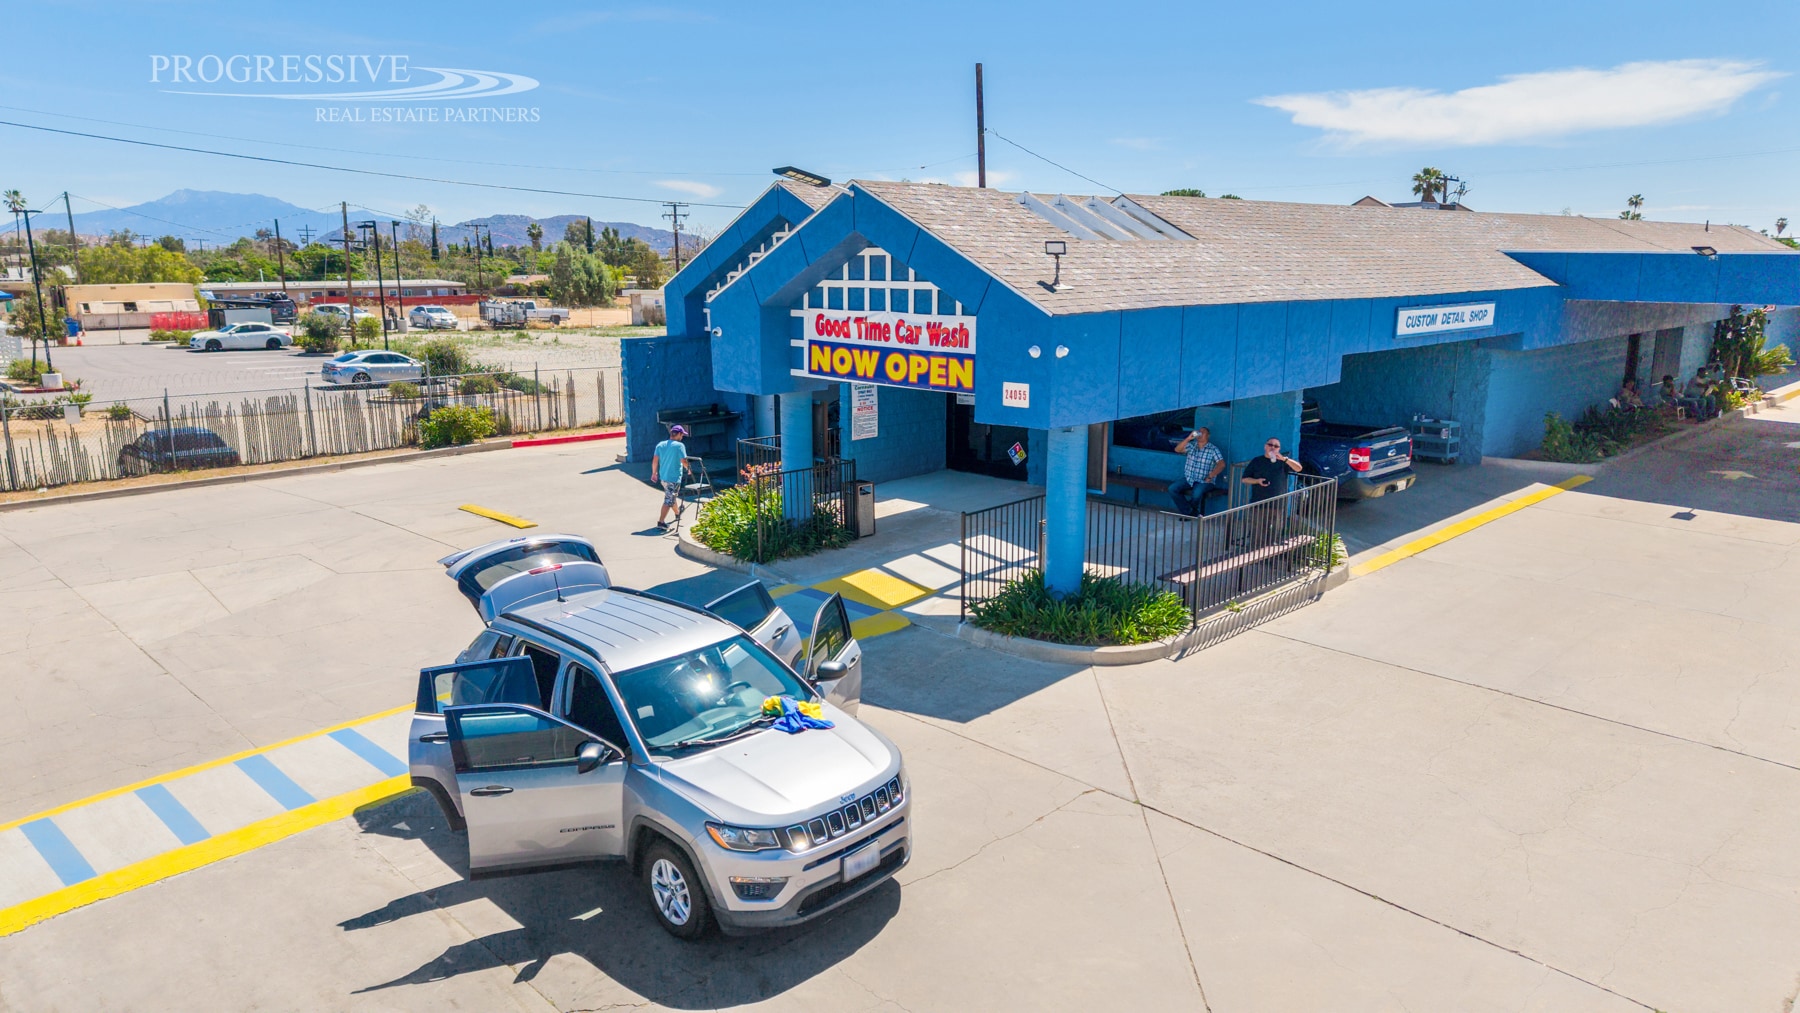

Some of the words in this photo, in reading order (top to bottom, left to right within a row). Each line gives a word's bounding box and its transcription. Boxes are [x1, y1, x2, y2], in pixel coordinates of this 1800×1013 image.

[1405, 313, 1438, 328] CUSTOM
[1441, 311, 1465, 325] DETAIL
[1468, 309, 1488, 322] SHOP
[815, 313, 851, 339] Good
[854, 316, 891, 343] Time
[895, 319, 922, 345] Car
[926, 321, 969, 348] Wash
[810, 344, 880, 378] NOW
[885, 352, 974, 388] OPEN
[1005, 389, 1027, 401] 24055
[559, 824, 615, 833] COMPASS
